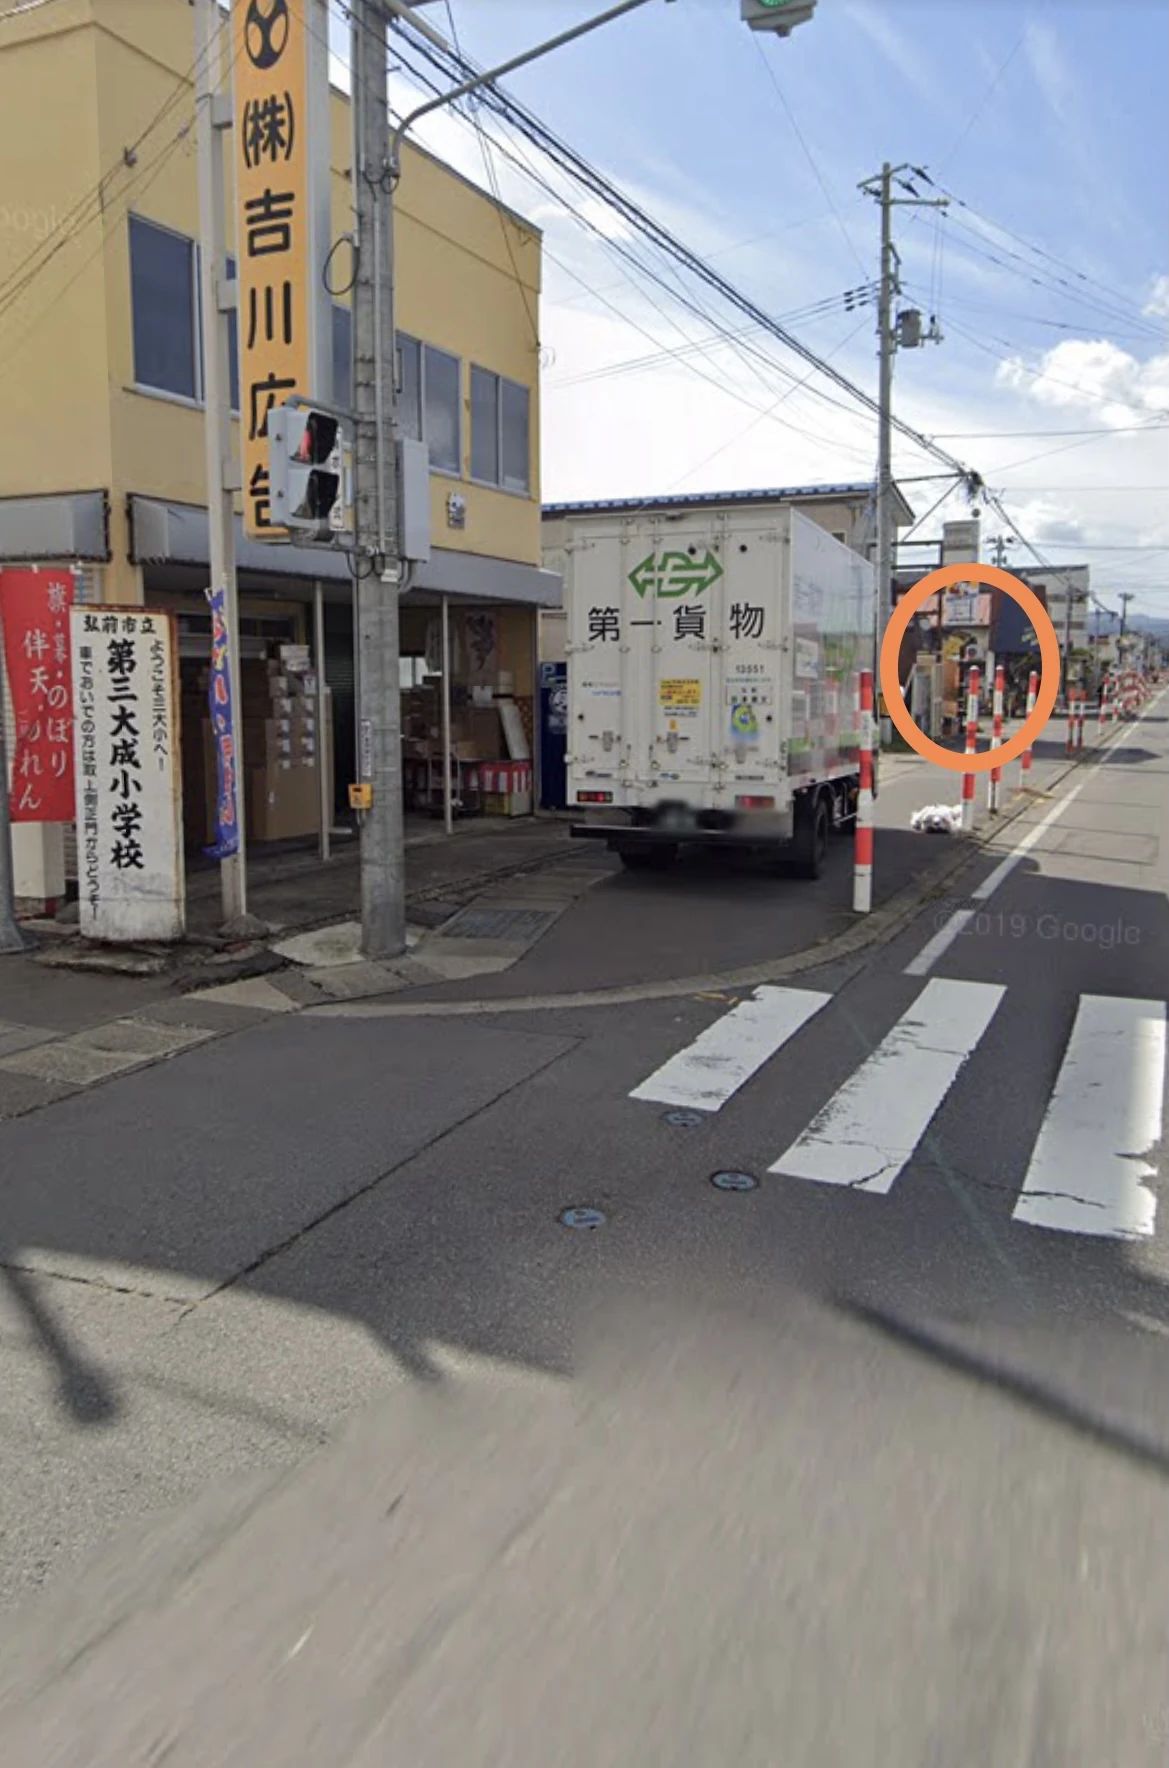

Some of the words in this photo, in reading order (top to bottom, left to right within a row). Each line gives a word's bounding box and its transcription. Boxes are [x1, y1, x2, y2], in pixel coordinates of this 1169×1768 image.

[83, 614, 156, 634] 弘前市立
[588, 603, 765, 642] 第一貨物
[107, 638, 144, 870] 第三大成小学校
